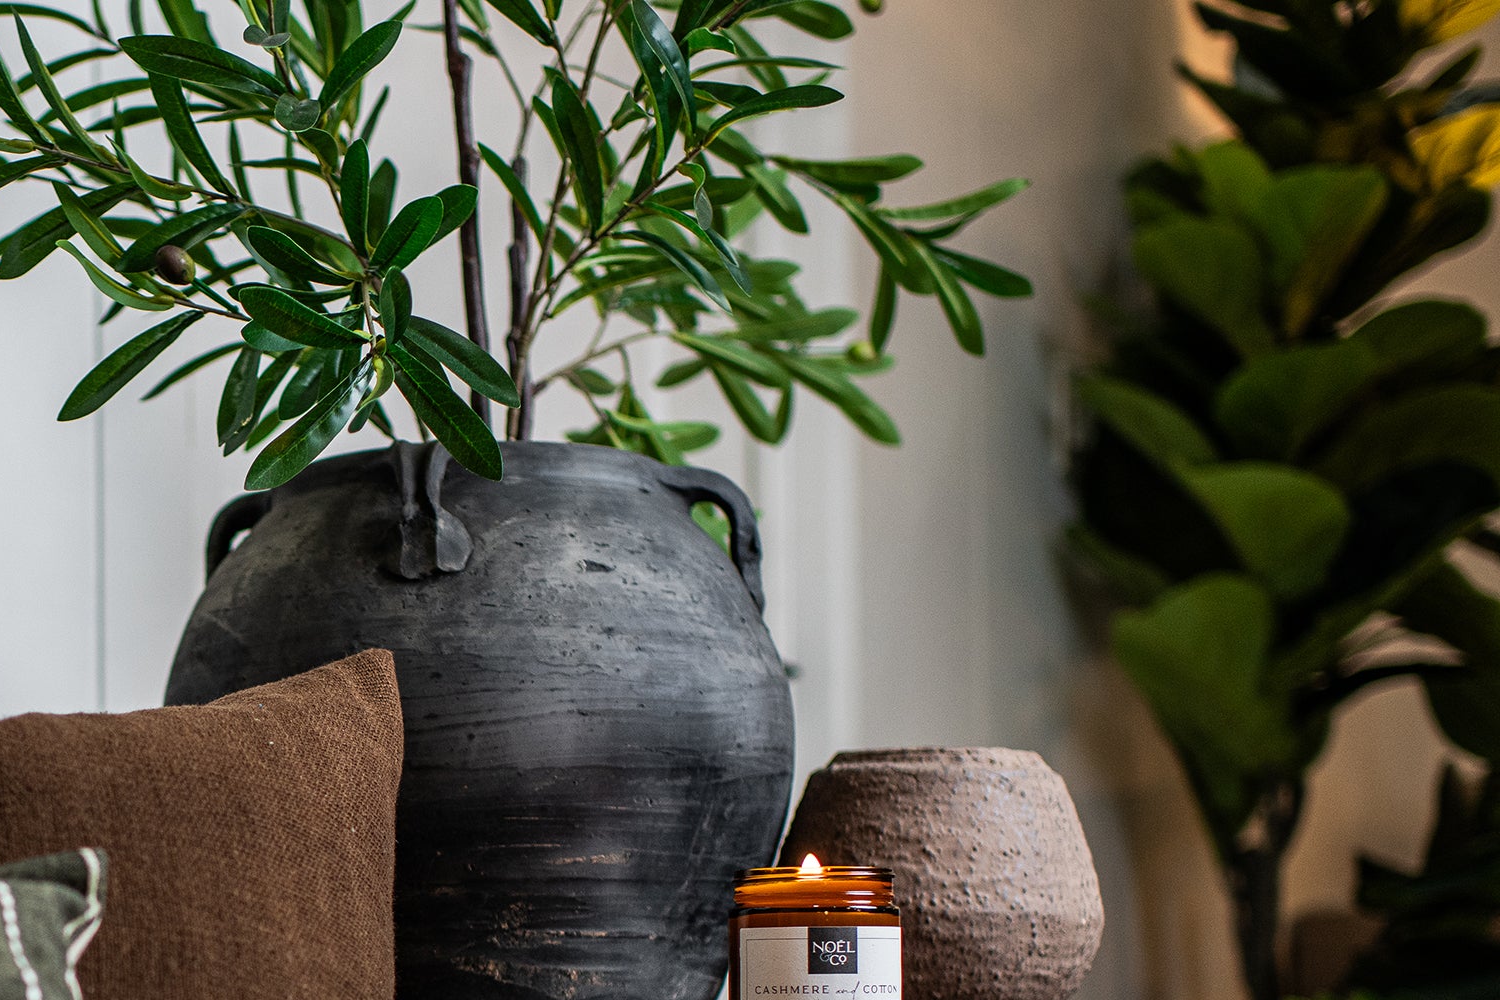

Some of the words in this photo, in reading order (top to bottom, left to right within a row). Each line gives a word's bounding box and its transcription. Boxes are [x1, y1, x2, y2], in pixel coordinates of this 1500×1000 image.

[754, 985, 829, 994] CASHMERE
[835, 980, 860, 1000] and
[862, 984, 897, 994] COTTON
